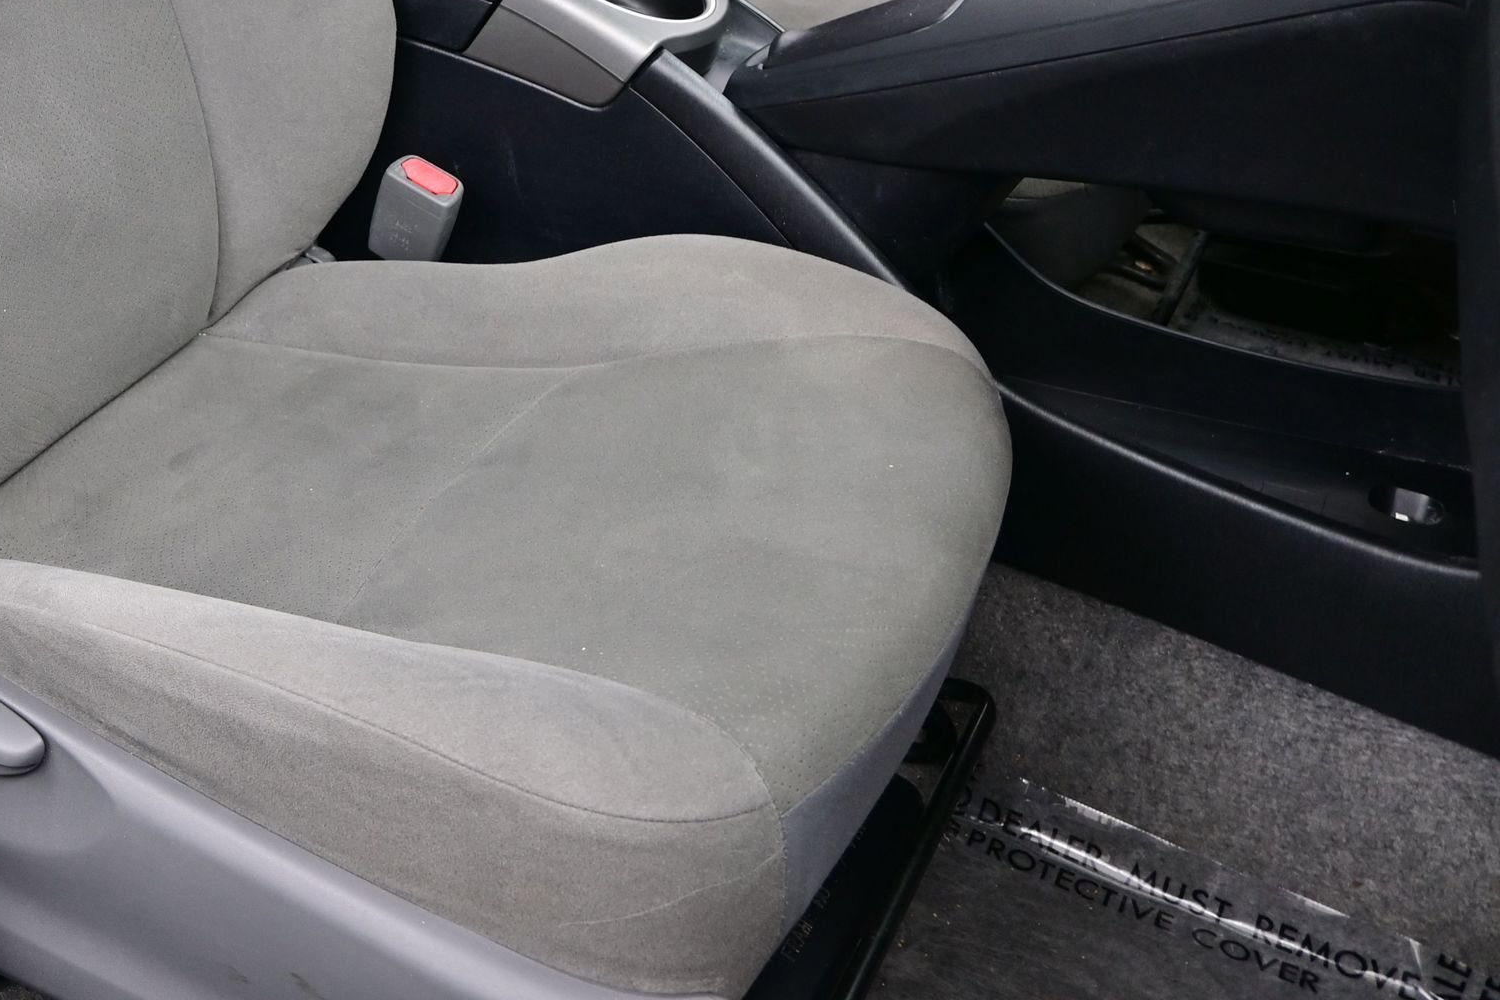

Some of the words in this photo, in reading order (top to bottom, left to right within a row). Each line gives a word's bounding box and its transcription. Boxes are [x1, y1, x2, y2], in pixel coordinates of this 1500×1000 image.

[966, 827, 1175, 932] PROTECTIVE
[1192, 928, 1320, 995] COVER
[977, 798, 1103, 873] DEALER
[1124, 861, 1233, 924] MUST
